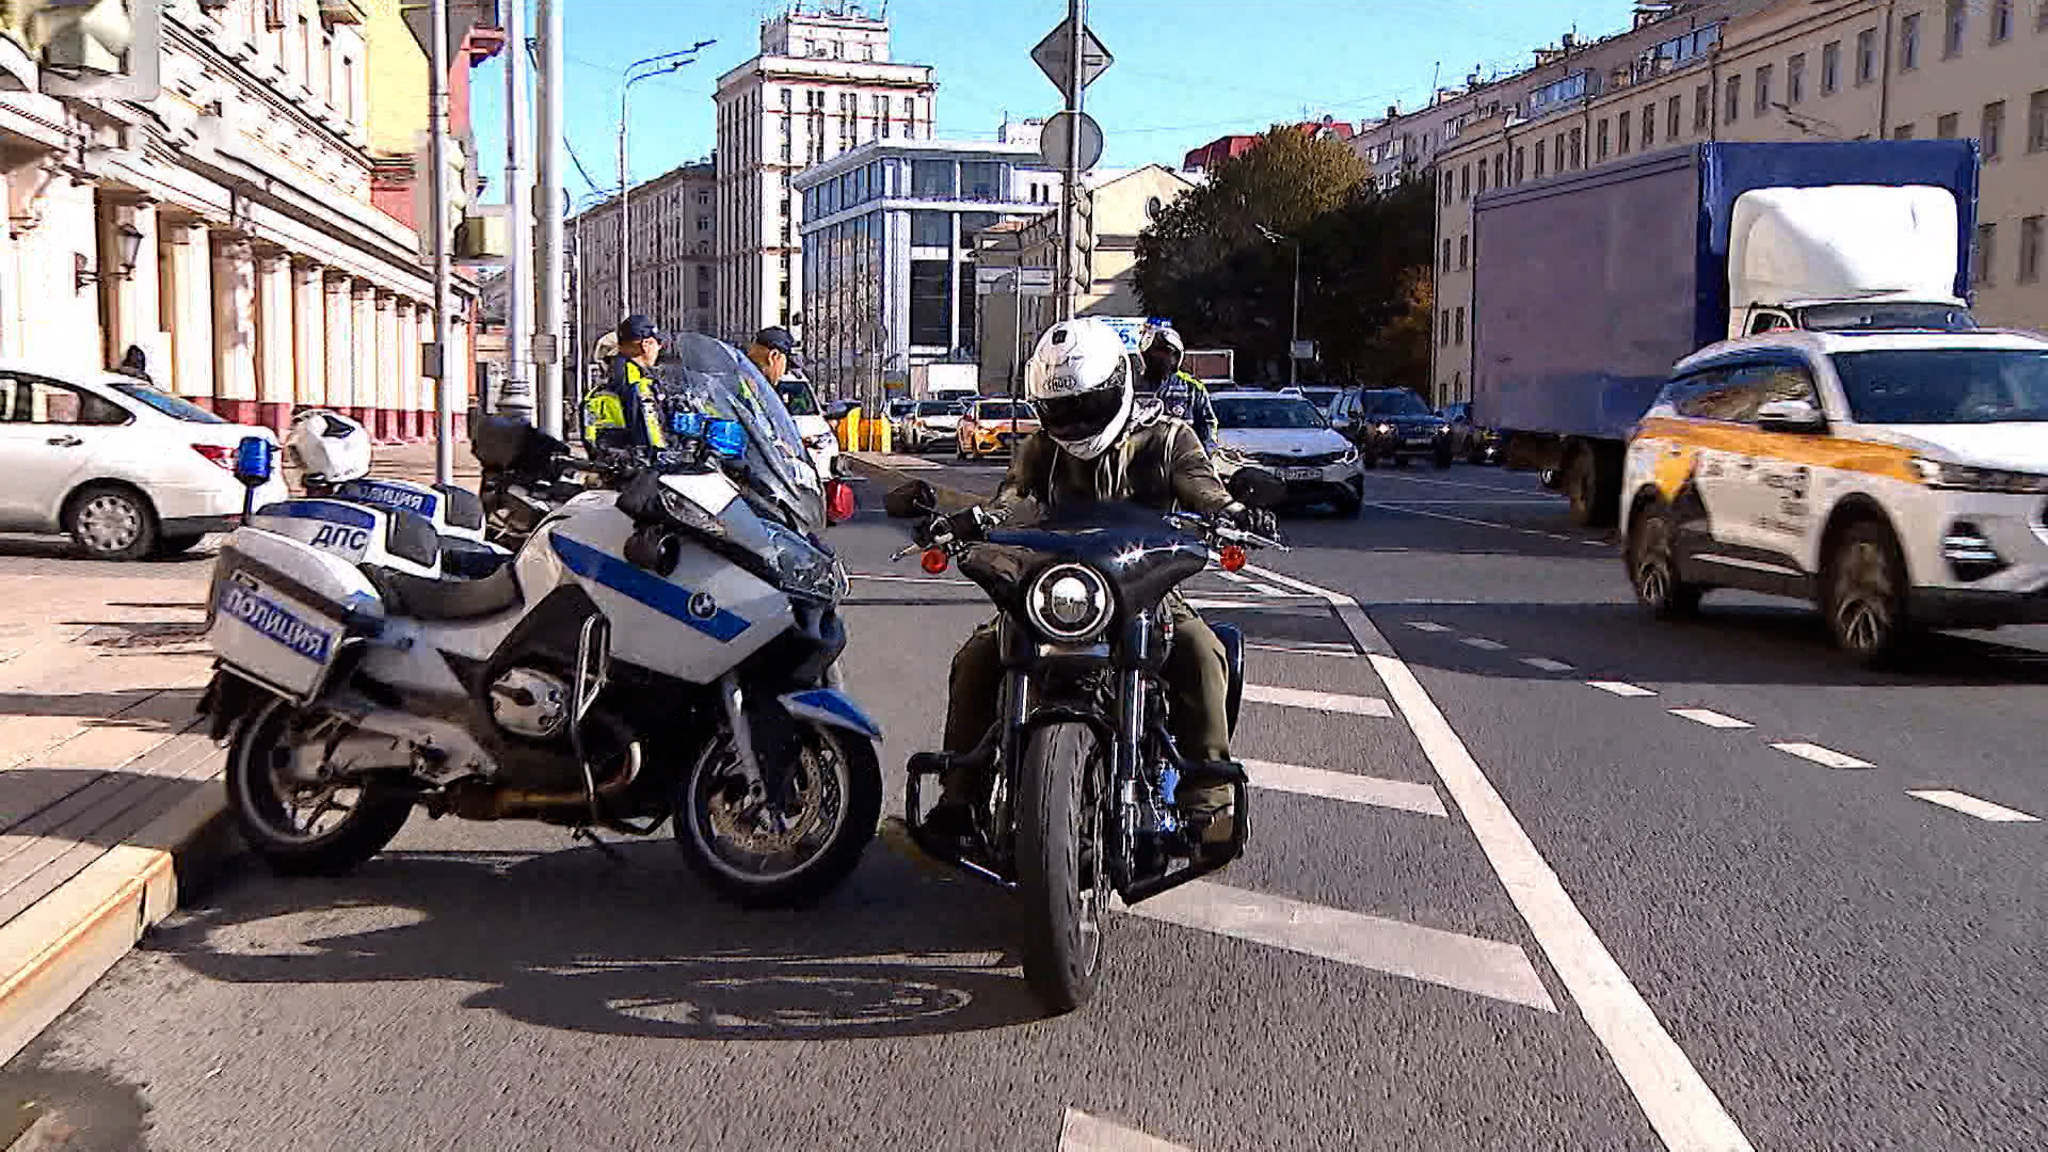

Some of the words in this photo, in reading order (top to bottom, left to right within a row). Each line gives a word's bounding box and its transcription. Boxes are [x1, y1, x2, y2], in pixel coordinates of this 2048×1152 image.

[351, 485, 424, 510] ОЛИЦИЯ
[310, 525, 367, 549] ДПС
[227, 590, 323, 656] ПОЛИЦИЯ
